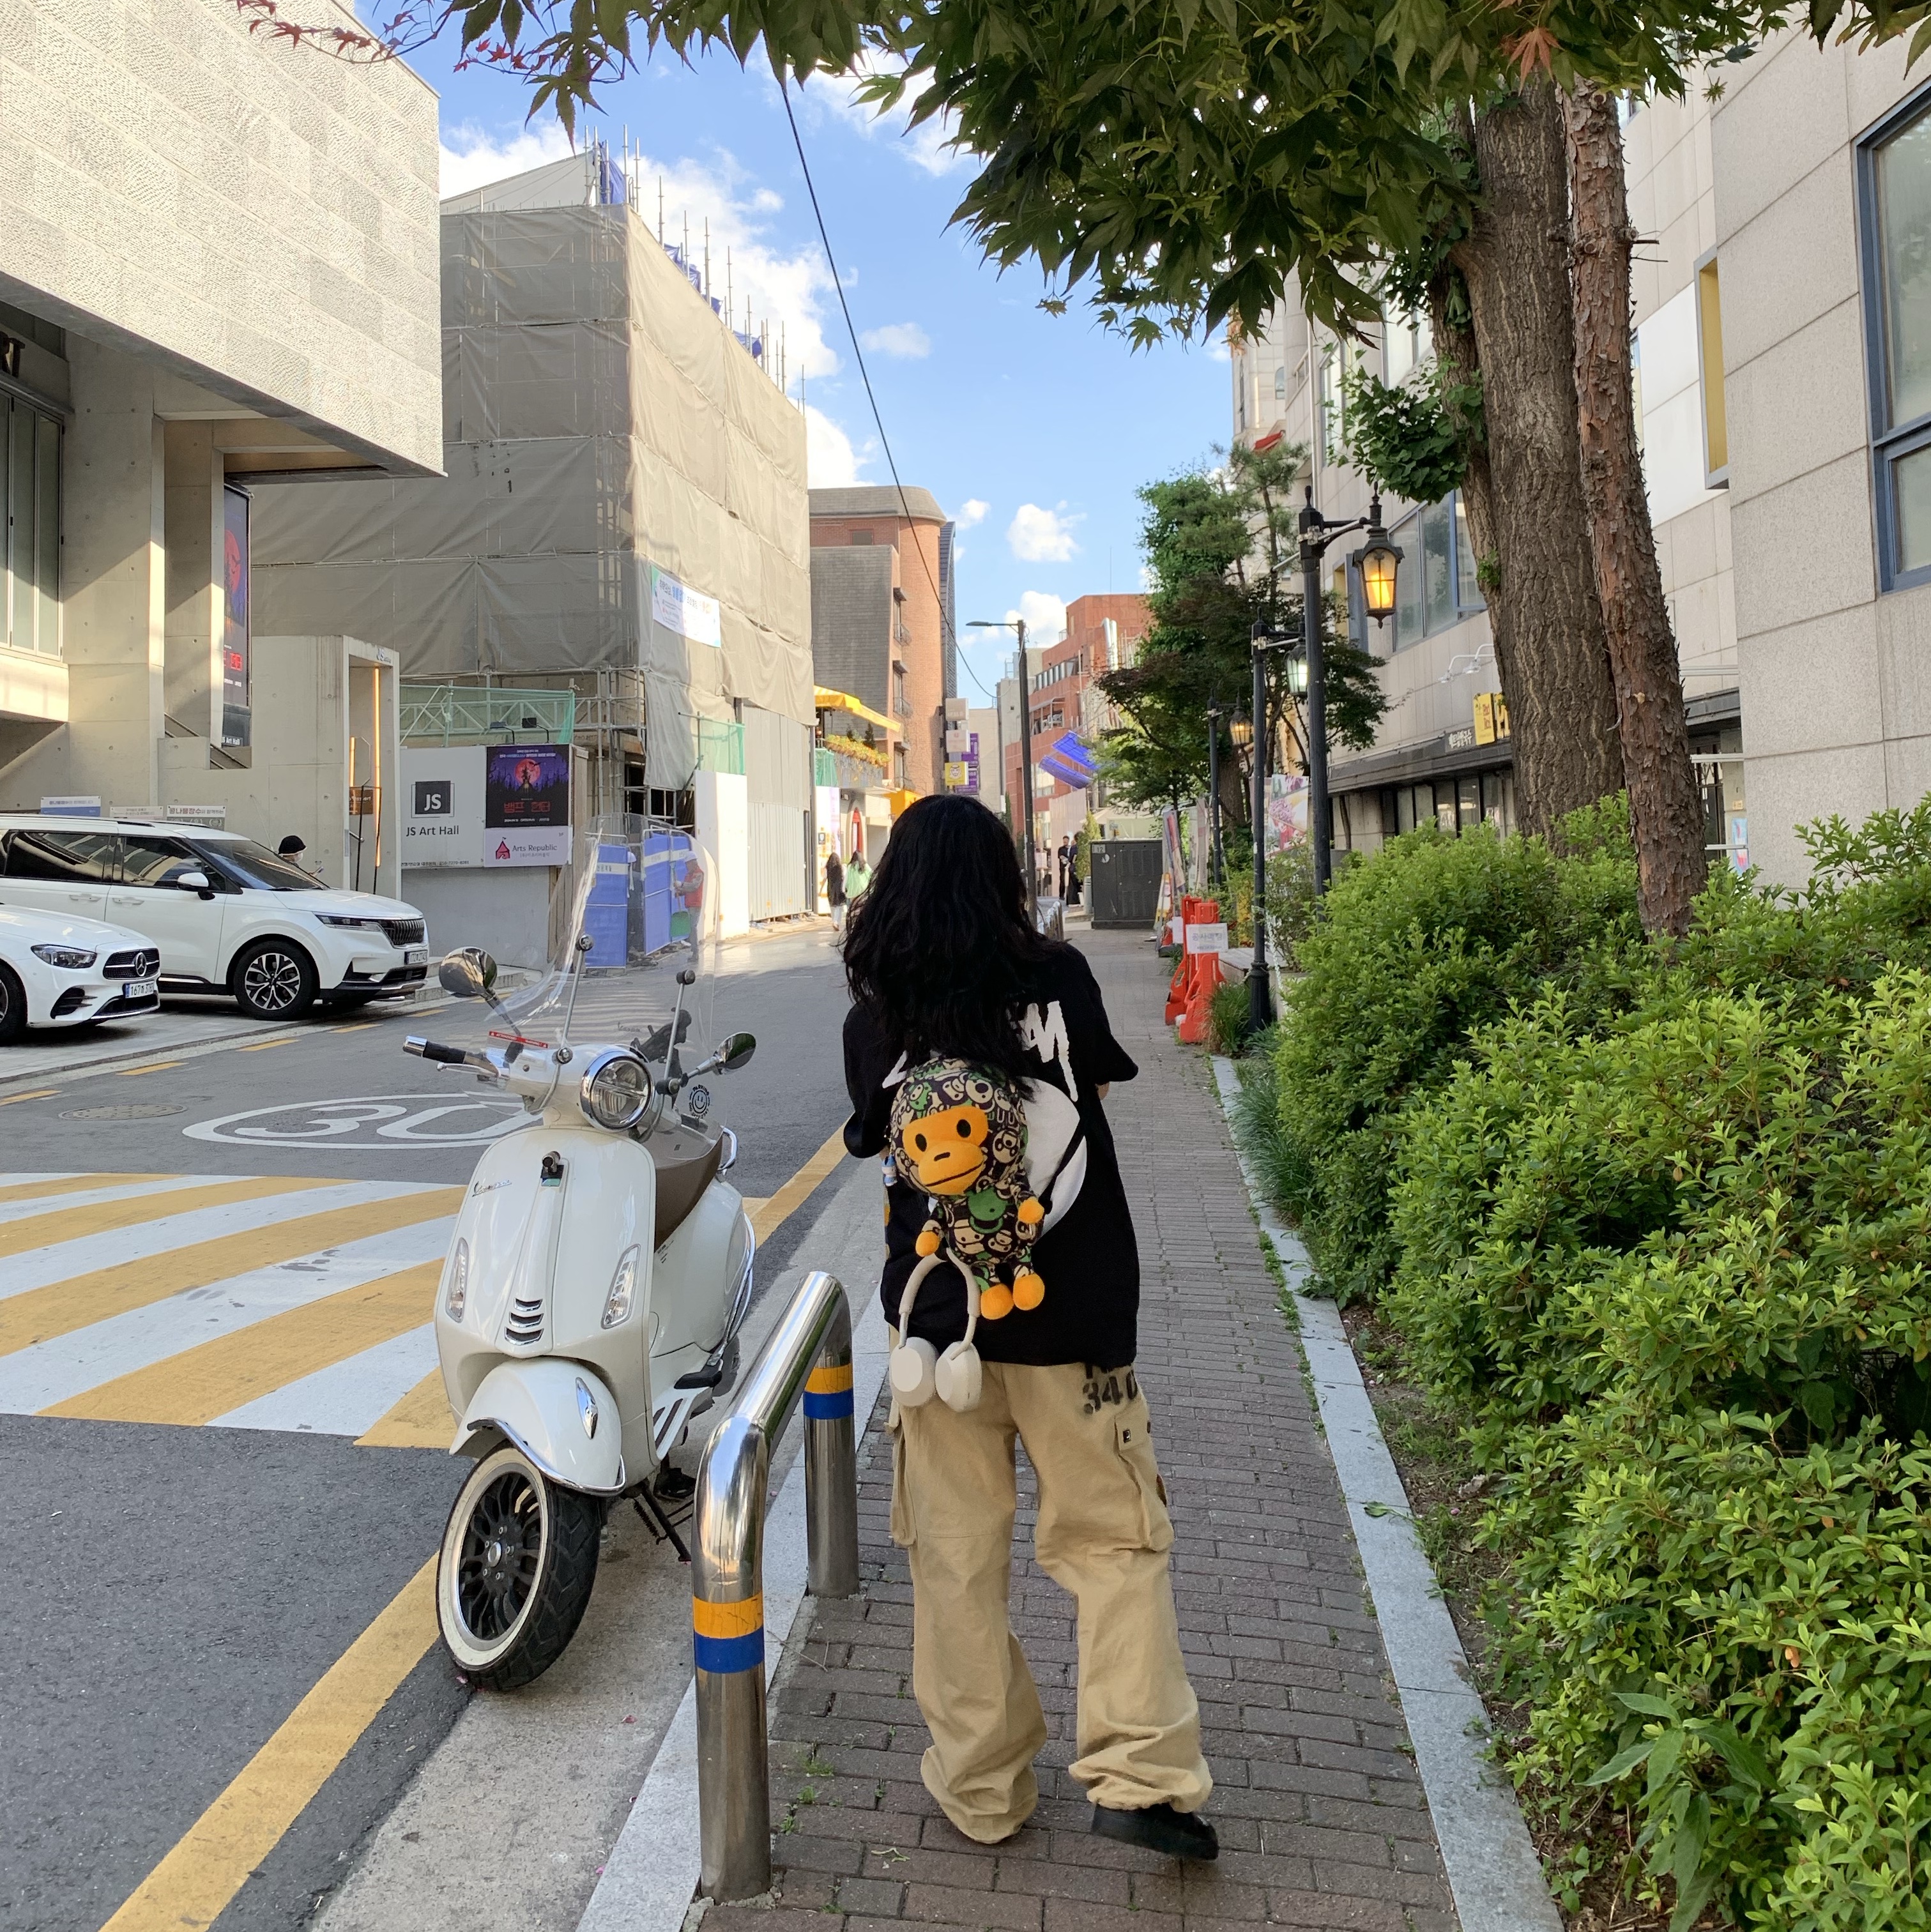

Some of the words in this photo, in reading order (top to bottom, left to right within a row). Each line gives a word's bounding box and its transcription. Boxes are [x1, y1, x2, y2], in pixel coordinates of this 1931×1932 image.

[424, 793, 442, 811] JS
[406, 827, 416, 837] JS
[420, 826, 436, 835] Art
[439, 825, 459, 835] Hall
[528, 844, 558, 852] Republic
